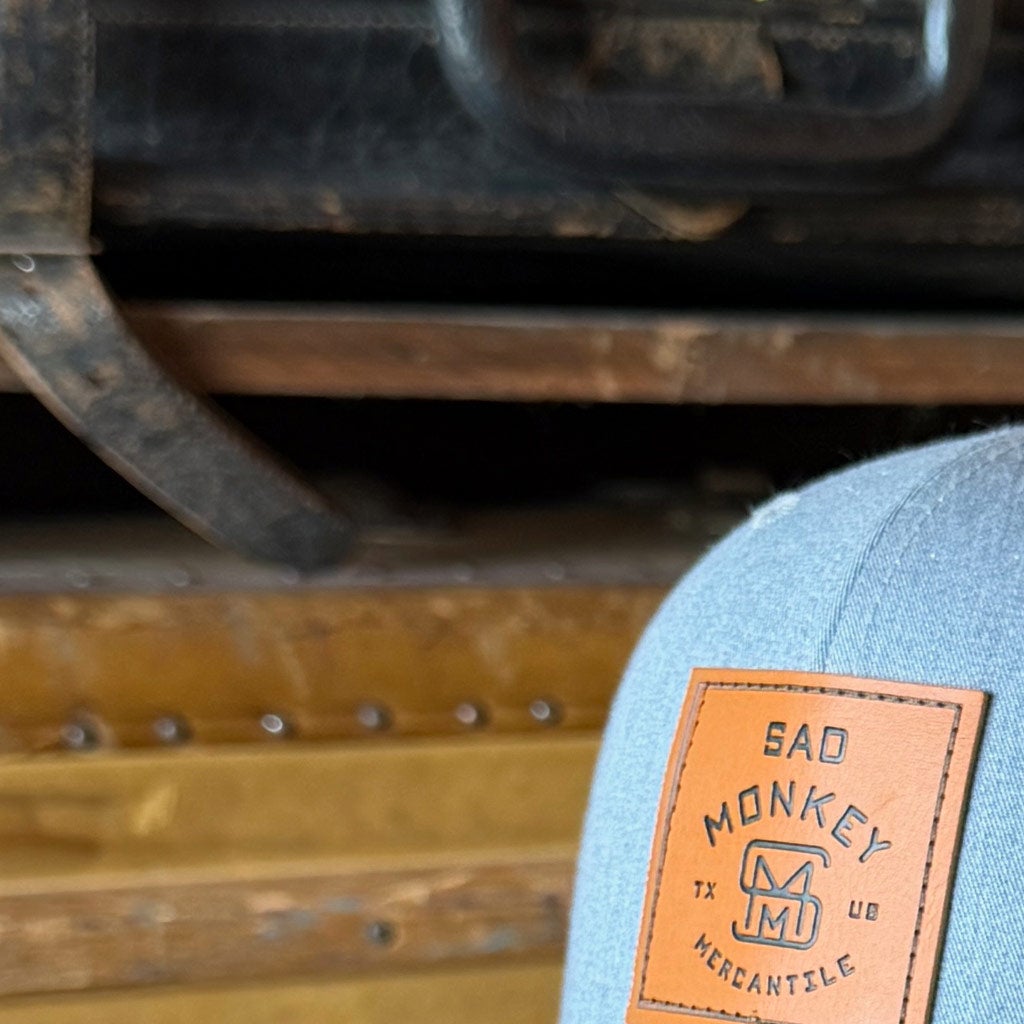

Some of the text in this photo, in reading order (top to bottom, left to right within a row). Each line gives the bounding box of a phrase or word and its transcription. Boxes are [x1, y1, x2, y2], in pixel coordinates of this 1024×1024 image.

[764, 721, 848, 764] SAD
[704, 780, 892, 863] MONKEY
[694, 880, 717, 900] TX
[694, 933, 855, 997] MERCANTILE
